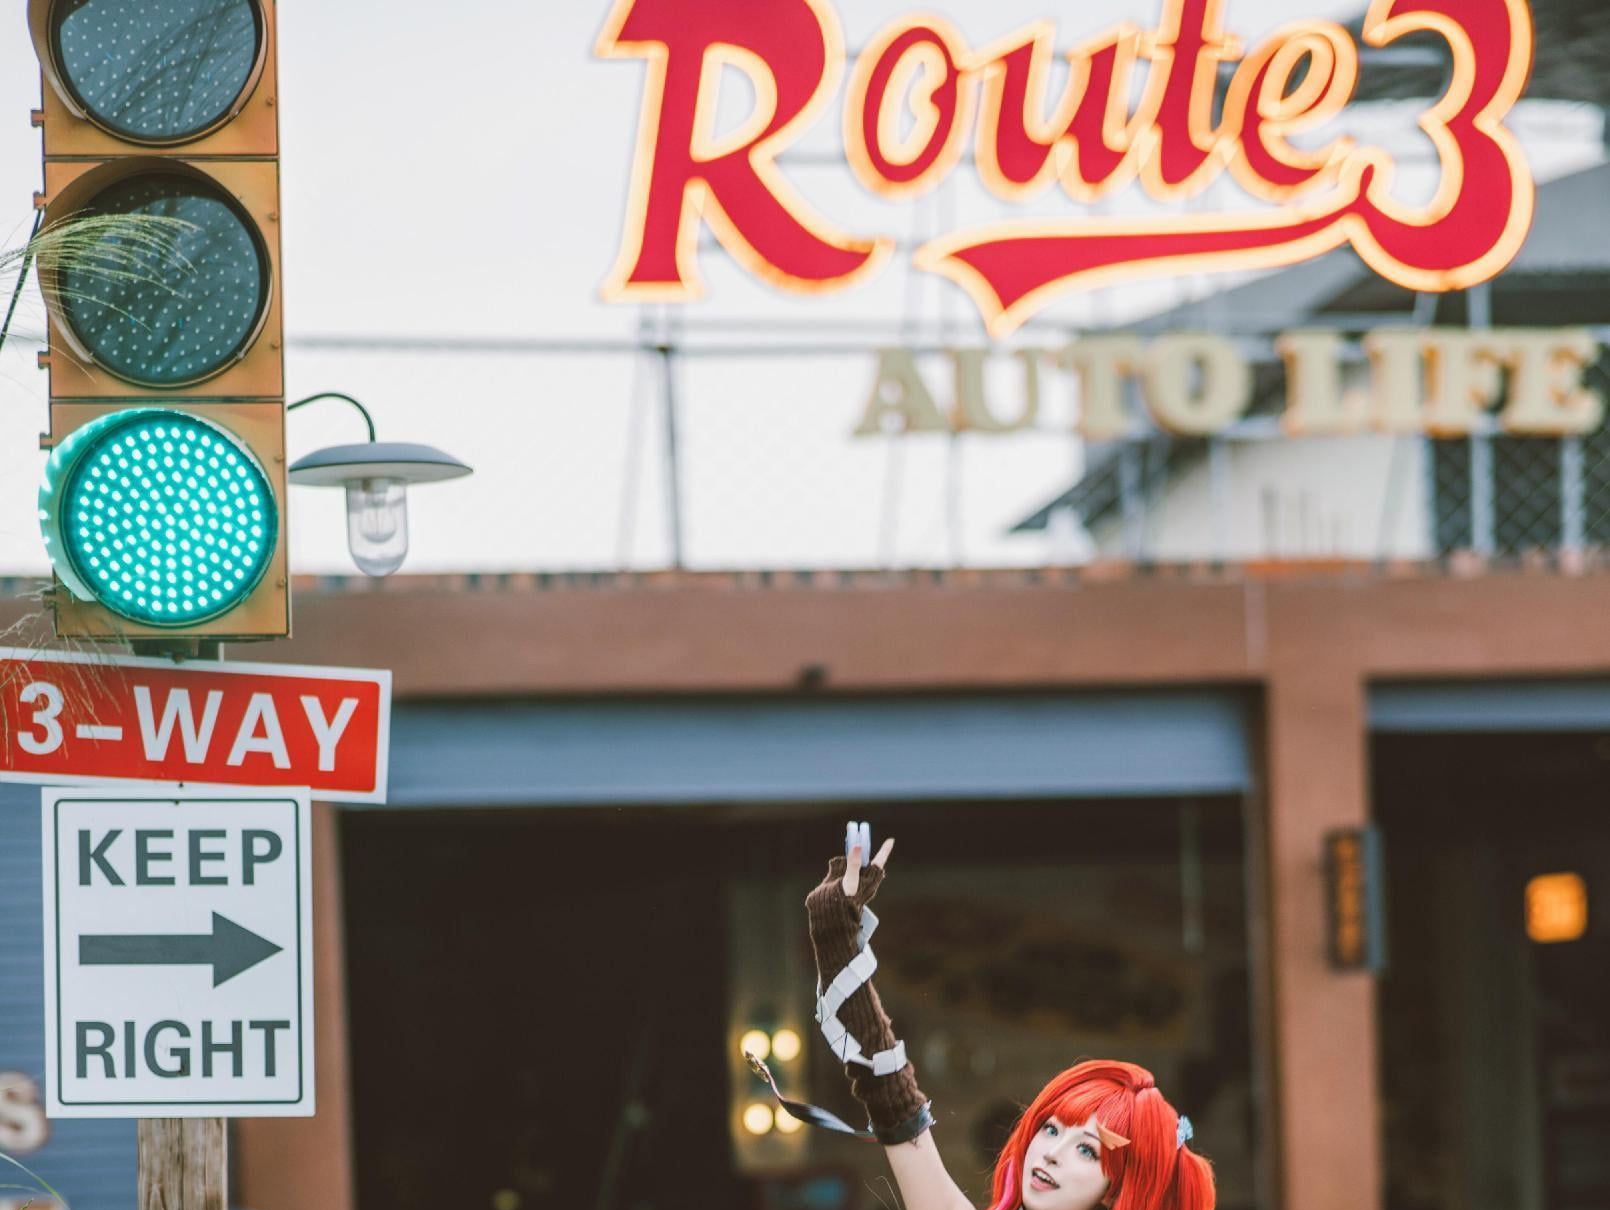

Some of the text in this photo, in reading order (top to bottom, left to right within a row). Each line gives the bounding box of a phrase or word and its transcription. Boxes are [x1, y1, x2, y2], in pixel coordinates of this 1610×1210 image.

[853, 328, 1607, 439] AUTO LIFE
[16, 680, 360, 773] 3-WAY
[77, 828, 284, 887] KEEP
[74, 1019, 292, 1080] RIGHT
